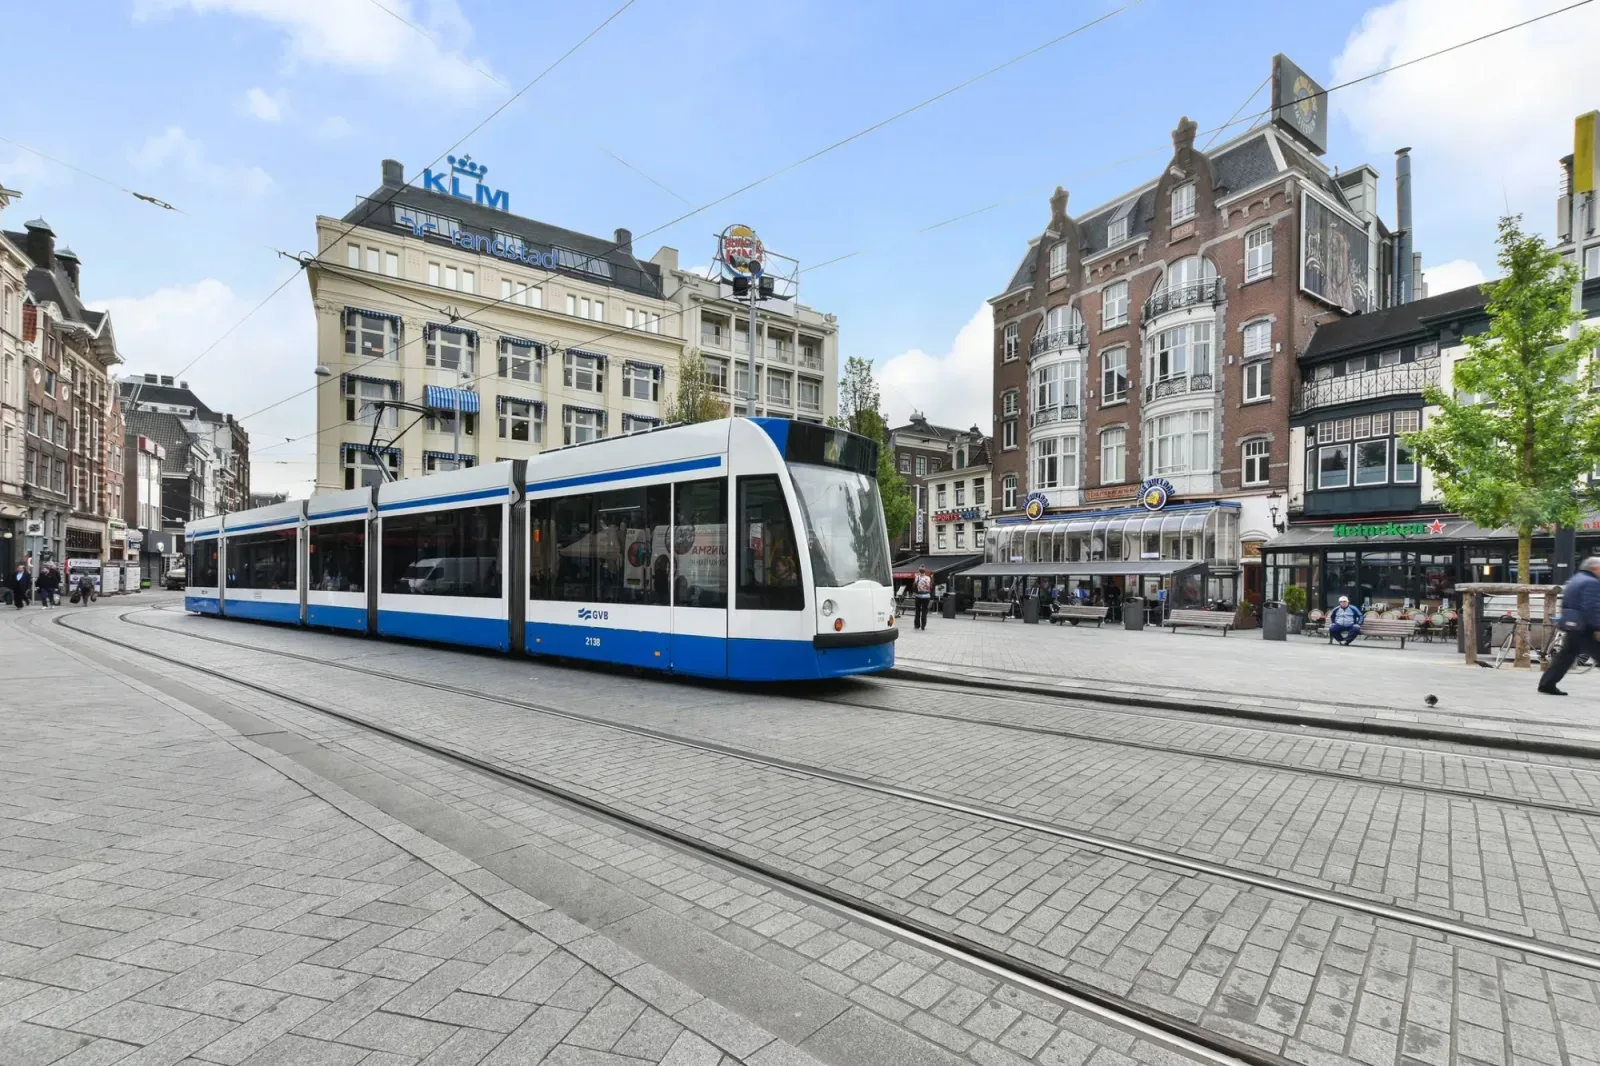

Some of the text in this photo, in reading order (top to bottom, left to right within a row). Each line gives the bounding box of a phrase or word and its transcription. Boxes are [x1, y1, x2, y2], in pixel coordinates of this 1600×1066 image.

[423, 168, 509, 212] KLM
[451, 228, 559, 270] randstad
[725, 238, 763, 254] BURGR
[1333, 521, 1425, 539] Heineken
[592, 610, 609, 620] GVB
[585, 636, 600, 647] 2138
